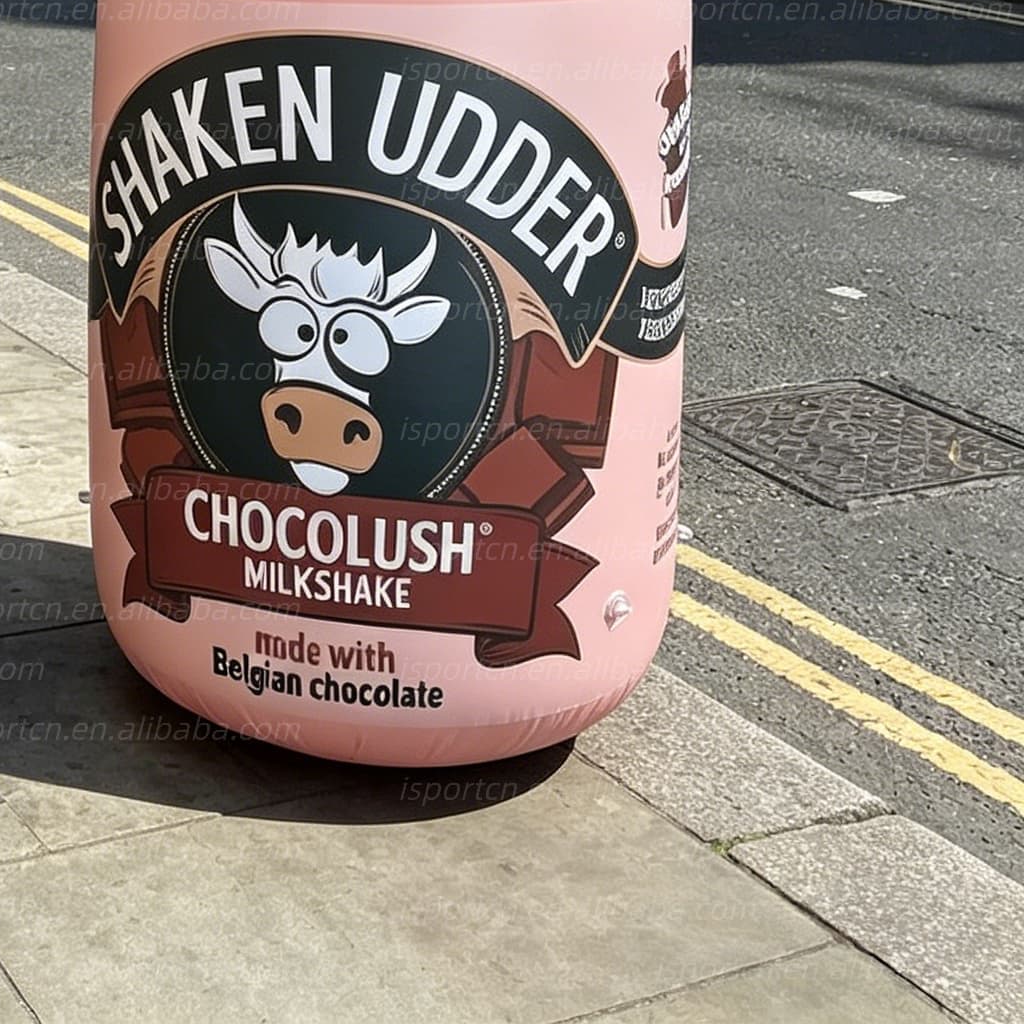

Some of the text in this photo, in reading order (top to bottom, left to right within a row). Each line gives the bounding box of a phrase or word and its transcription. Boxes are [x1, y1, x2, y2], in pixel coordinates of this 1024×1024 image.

[101, 65, 332, 267] SHAKEN
[244, 557, 411, 608] MILKSHAKE
[212, 646, 443, 708] Belgian chocolate
[328, 641, 395, 673] with
